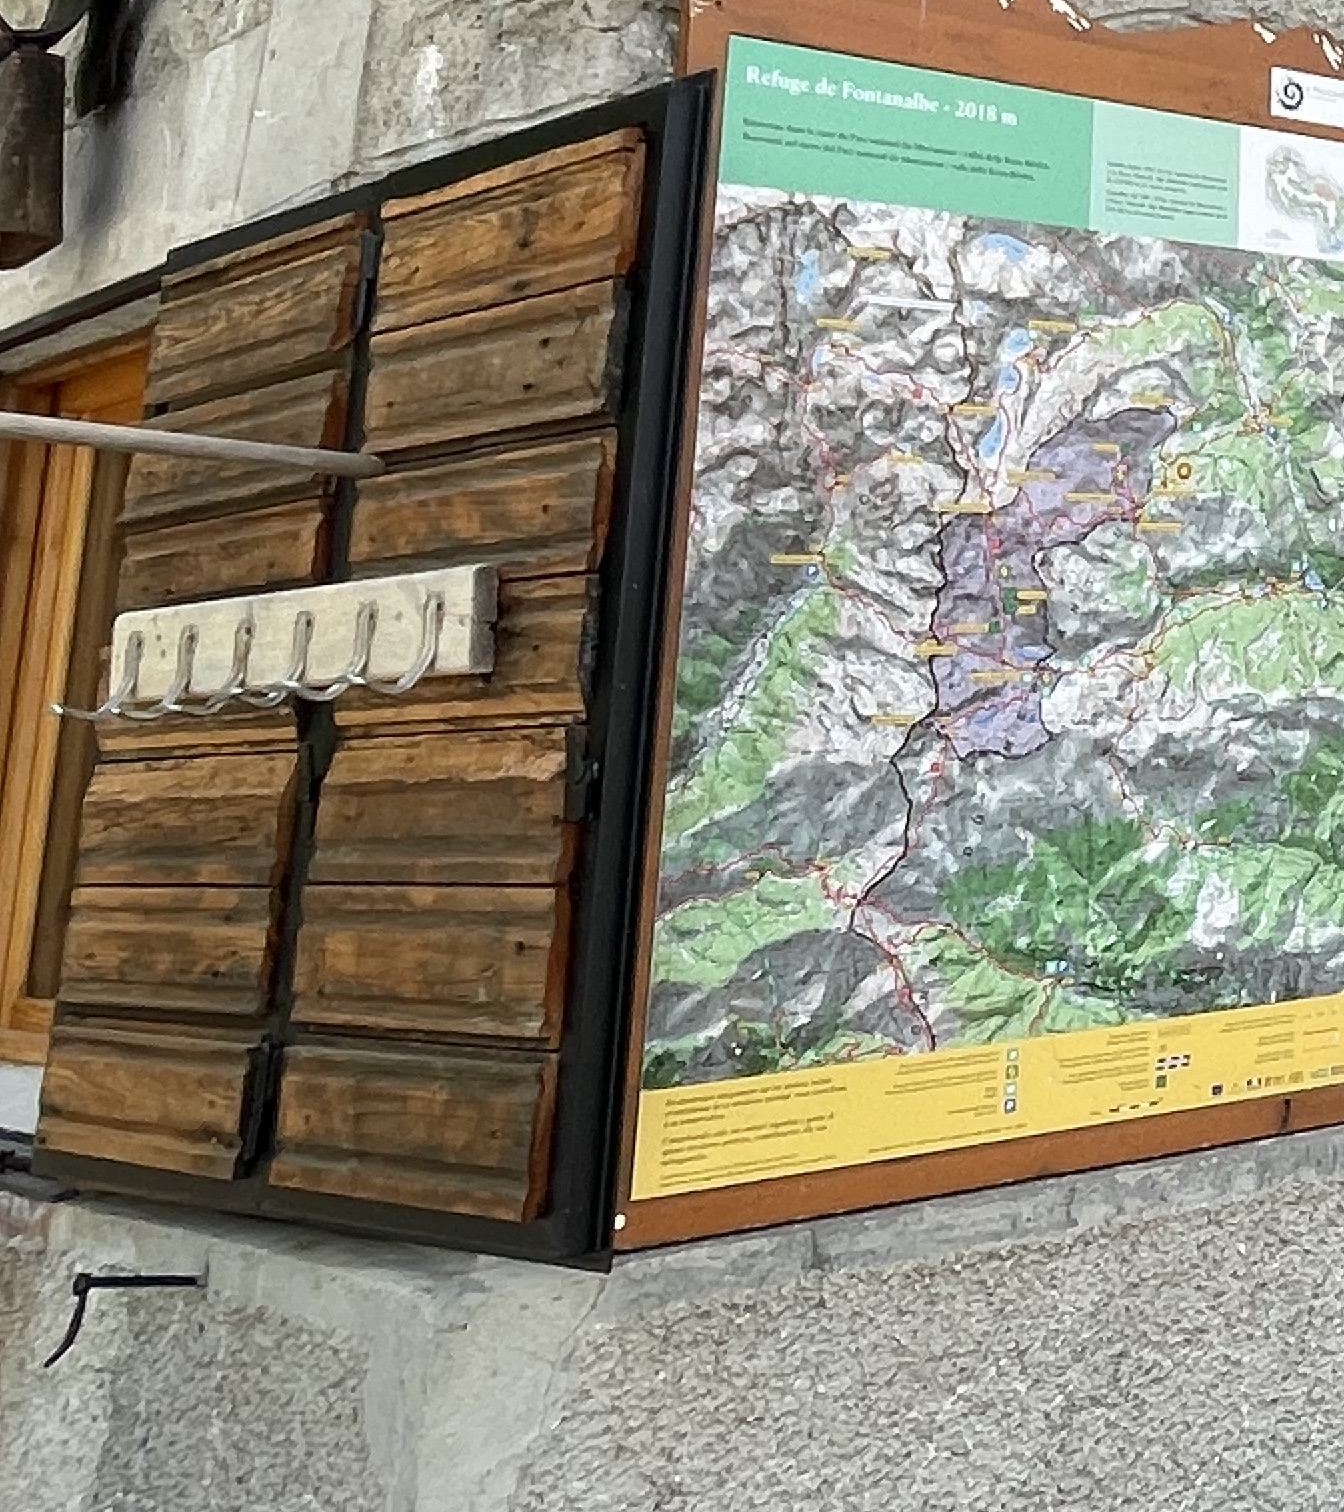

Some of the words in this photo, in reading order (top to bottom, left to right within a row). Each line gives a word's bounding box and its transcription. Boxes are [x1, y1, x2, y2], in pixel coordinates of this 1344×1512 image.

[746, 65, 811, 96] Refuge
[815, 77, 836, 97] de
[842, 80, 939, 113] Fontanalbe
[954, 99, 998, 122] 2018
[1001, 111, 1018, 126] m
